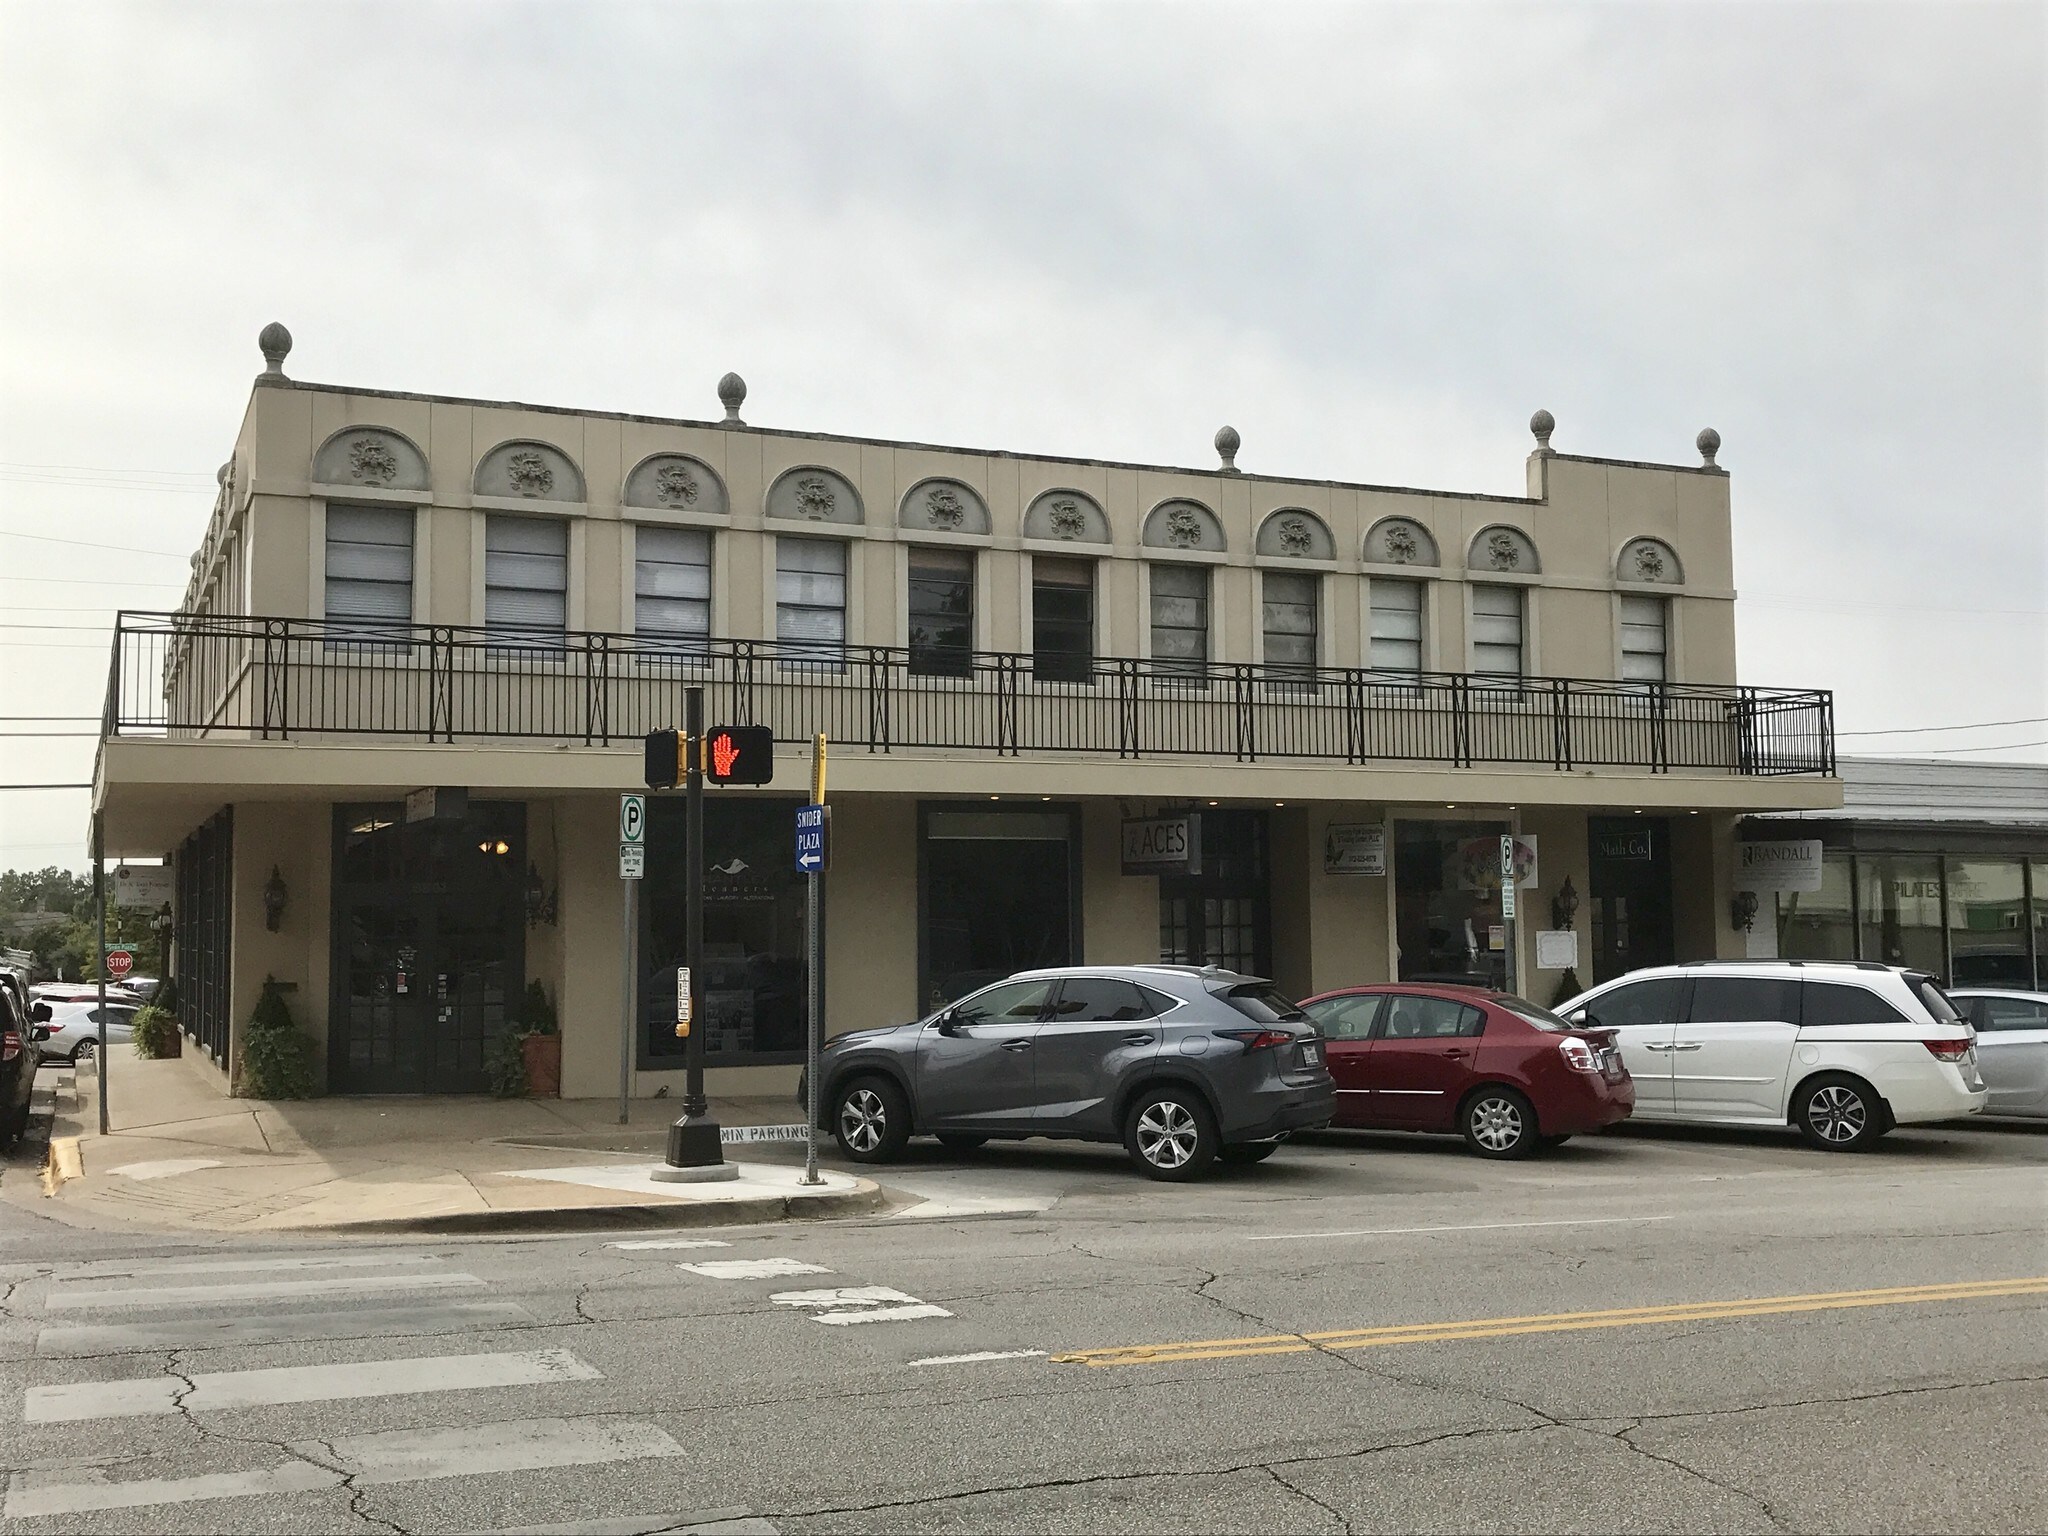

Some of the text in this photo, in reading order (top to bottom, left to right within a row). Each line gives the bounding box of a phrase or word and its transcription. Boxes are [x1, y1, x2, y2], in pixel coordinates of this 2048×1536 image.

[628, 806, 639, 832] P
[797, 810, 822, 828] SNIDER
[798, 833, 820, 850] PLAZA
[1141, 823, 1185, 854] ACES
[1600, 838, 1647, 856] Math Co.
[702, 884, 768, 892] leaners
[1891, 881, 1941, 898] PILATES
[109, 957, 131, 967] STOP
[721, 1126, 808, 1141] MIN PARKING
